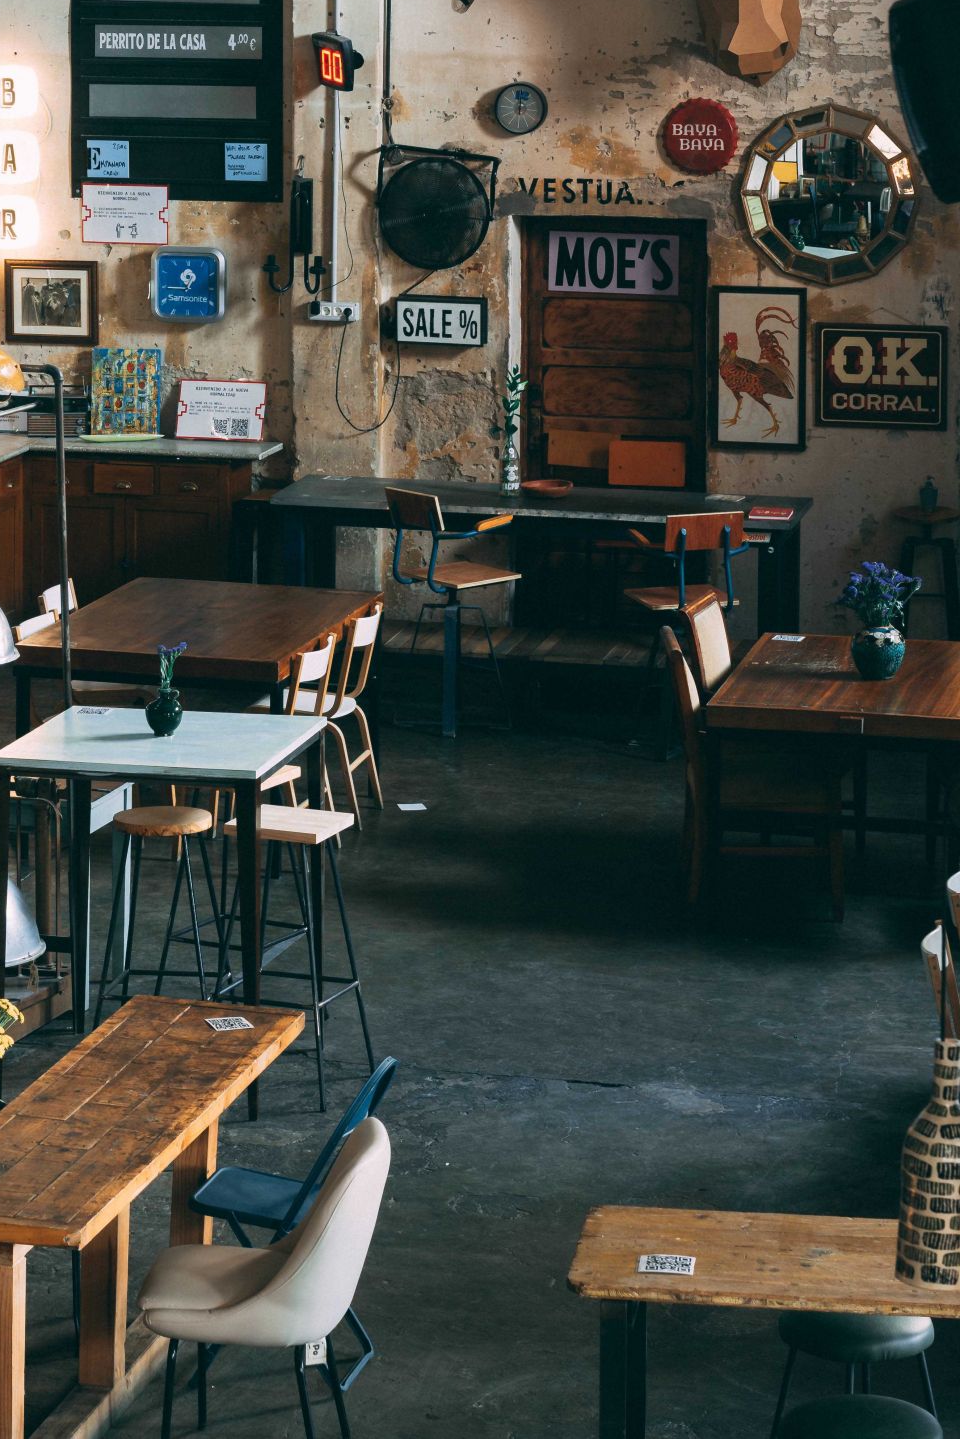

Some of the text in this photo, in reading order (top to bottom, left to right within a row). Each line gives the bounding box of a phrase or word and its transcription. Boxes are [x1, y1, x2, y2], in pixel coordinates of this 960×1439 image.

[99, 32, 144, 50] PERRITO
[147, 33, 161, 50] DE
[163, 33, 176, 50] LA
[179, 33, 207, 51] CASA
[321, 49, 344, 83] 00
[679, 138, 725, 151] BAYA
[555, 236, 674, 291] MOE'S
[167, 294, 208, 303] Samsonite
[403, 307, 453, 338] SALE
[828, 336, 938, 387] O.K.
[832, 392, 936, 413] CORRAL.
